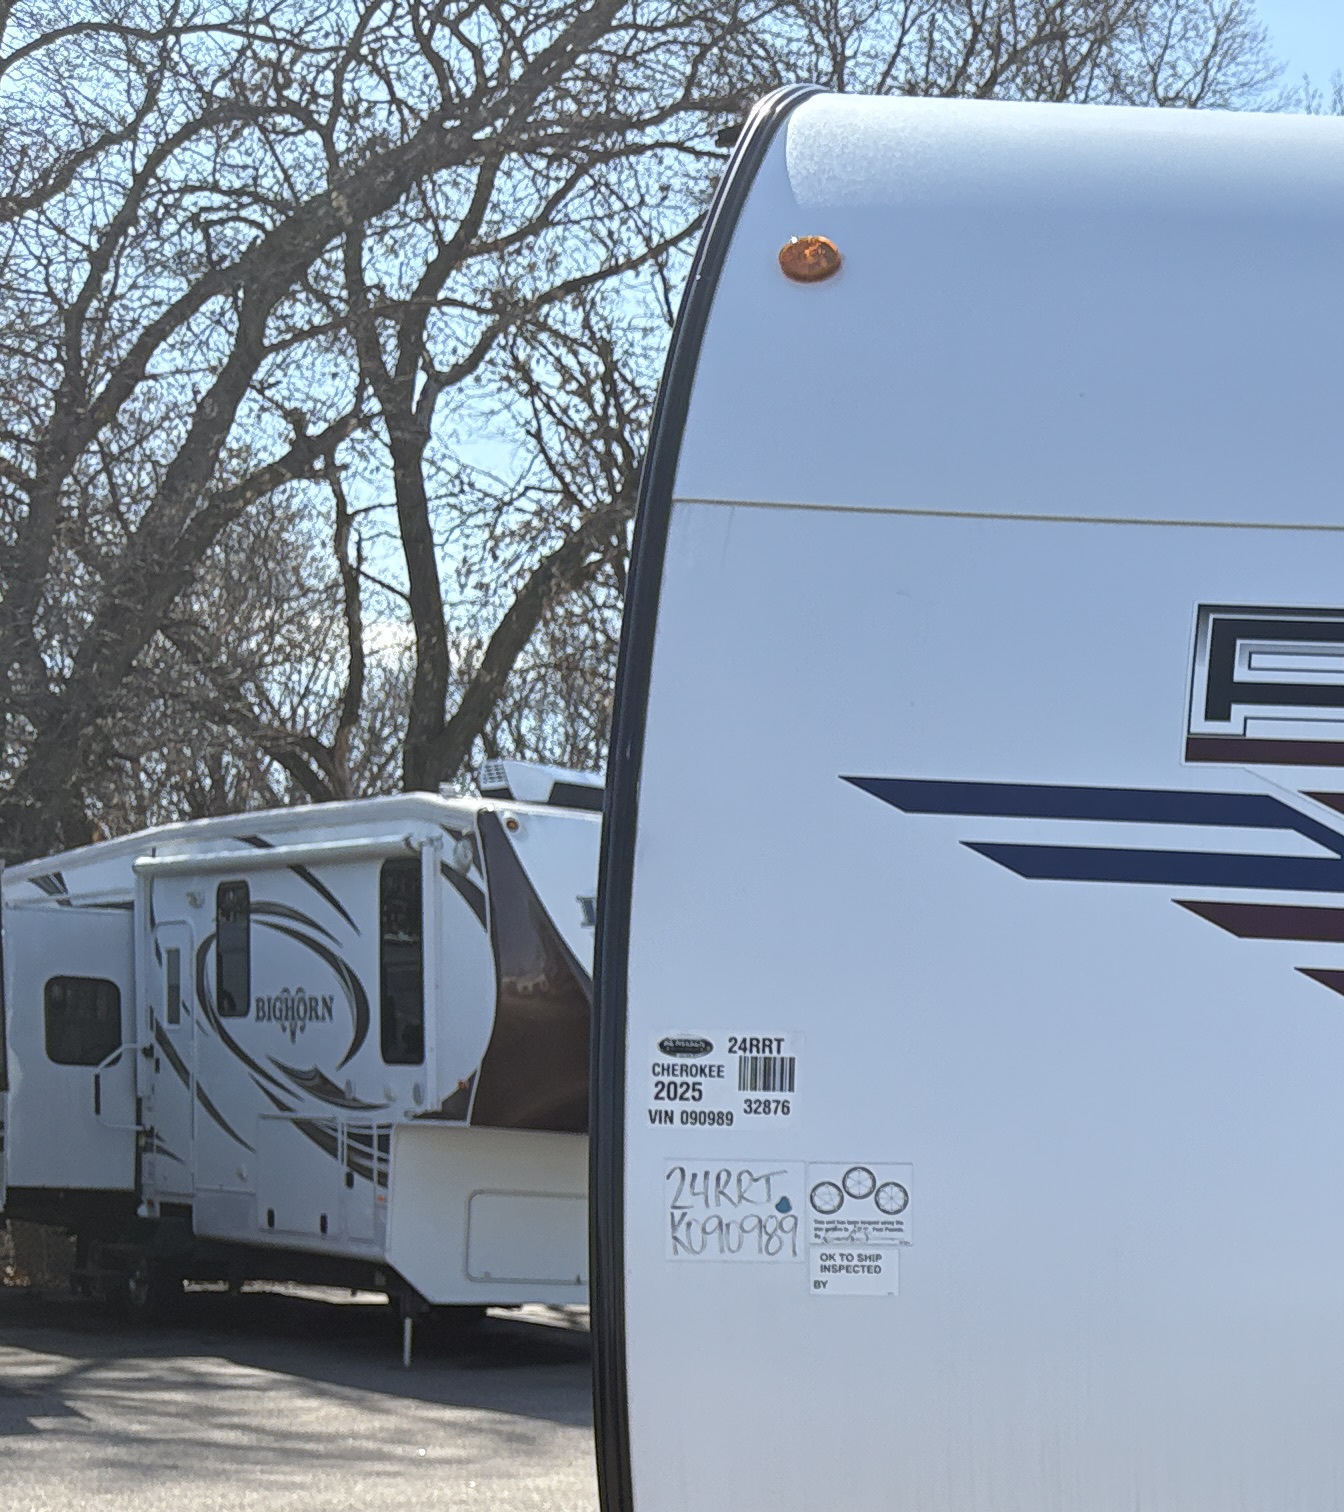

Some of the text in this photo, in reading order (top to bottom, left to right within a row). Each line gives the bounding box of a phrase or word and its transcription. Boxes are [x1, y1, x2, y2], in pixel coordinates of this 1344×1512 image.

[254, 994, 334, 1022] BIGHORN
[728, 1036, 785, 1055] 24RRT
[651, 1062, 725, 1079] CHEROKEE
[654, 1080, 703, 1102] 2025
[743, 1098, 791, 1116] 32876
[648, 1108, 734, 1127] VIN 090989
[666, 1166, 788, 1209] 24RRT
[819, 1252, 883, 1263] OK TO SHIP
[819, 1263, 882, 1274] INSPECTED
[813, 1279, 828, 1289] BY
